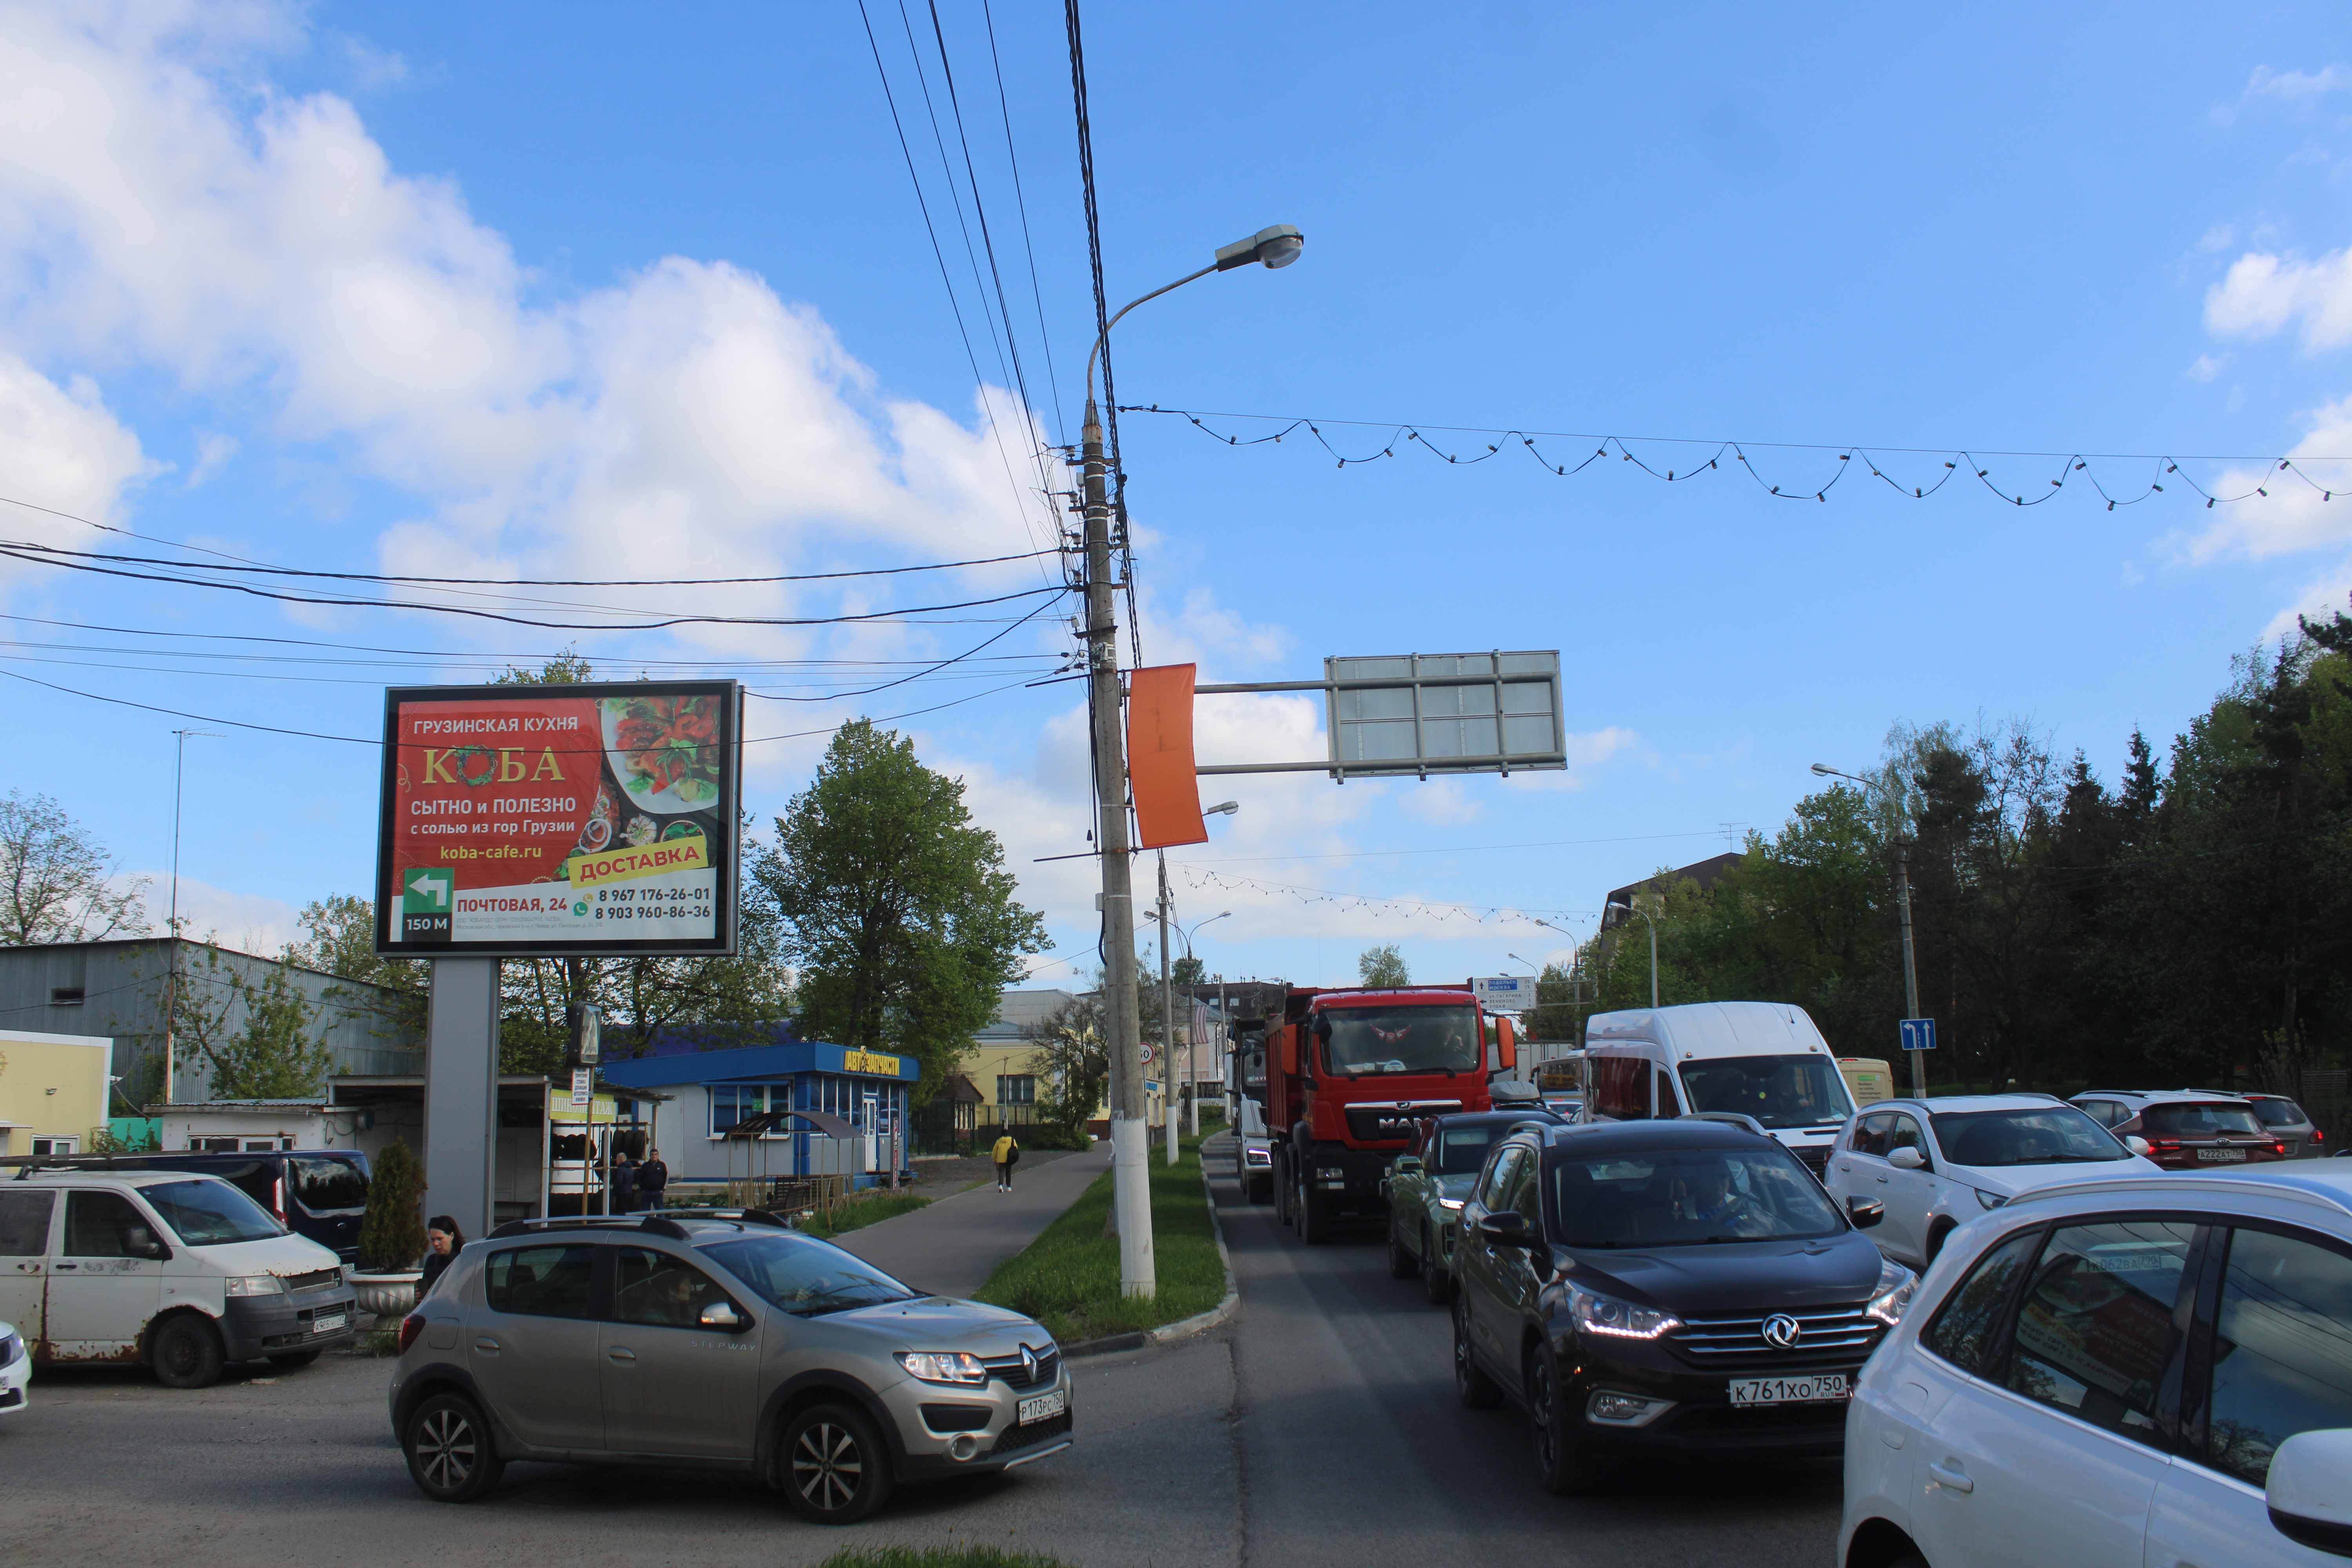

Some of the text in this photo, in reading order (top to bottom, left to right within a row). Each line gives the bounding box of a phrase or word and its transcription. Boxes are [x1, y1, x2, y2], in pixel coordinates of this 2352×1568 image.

[414, 717, 578, 734] ГРУЗИНСКАЯ КУХНЯ
[422, 745, 565, 786] КОБА
[411, 797, 576, 815] СЫТНО и ПОЛЕЗНО
[411, 820, 575, 835] с солью из гор Грузии
[440, 845, 542, 859] koba-cafe.ru
[580, 846, 700, 882] ДОСТАВКА
[599, 888, 710, 902] 8 967 176-26-01
[457, 897, 568, 913] ПОЧТОВАЯ, 24
[595, 906, 710, 919] 8 903 960-86-36
[407, 918, 448, 930] 150 М
[1141, 1050, 1149, 1058] 0
[2200, 1150, 2230, 1158] А222АТ
[691, 1340, 756, 1351] STEPWAY
[1736, 1376, 1842, 1401] К761ХО 750
[1022, 1399, 1052, 1419] Р173РС
[1053, 1392, 1063, 1405] 750
